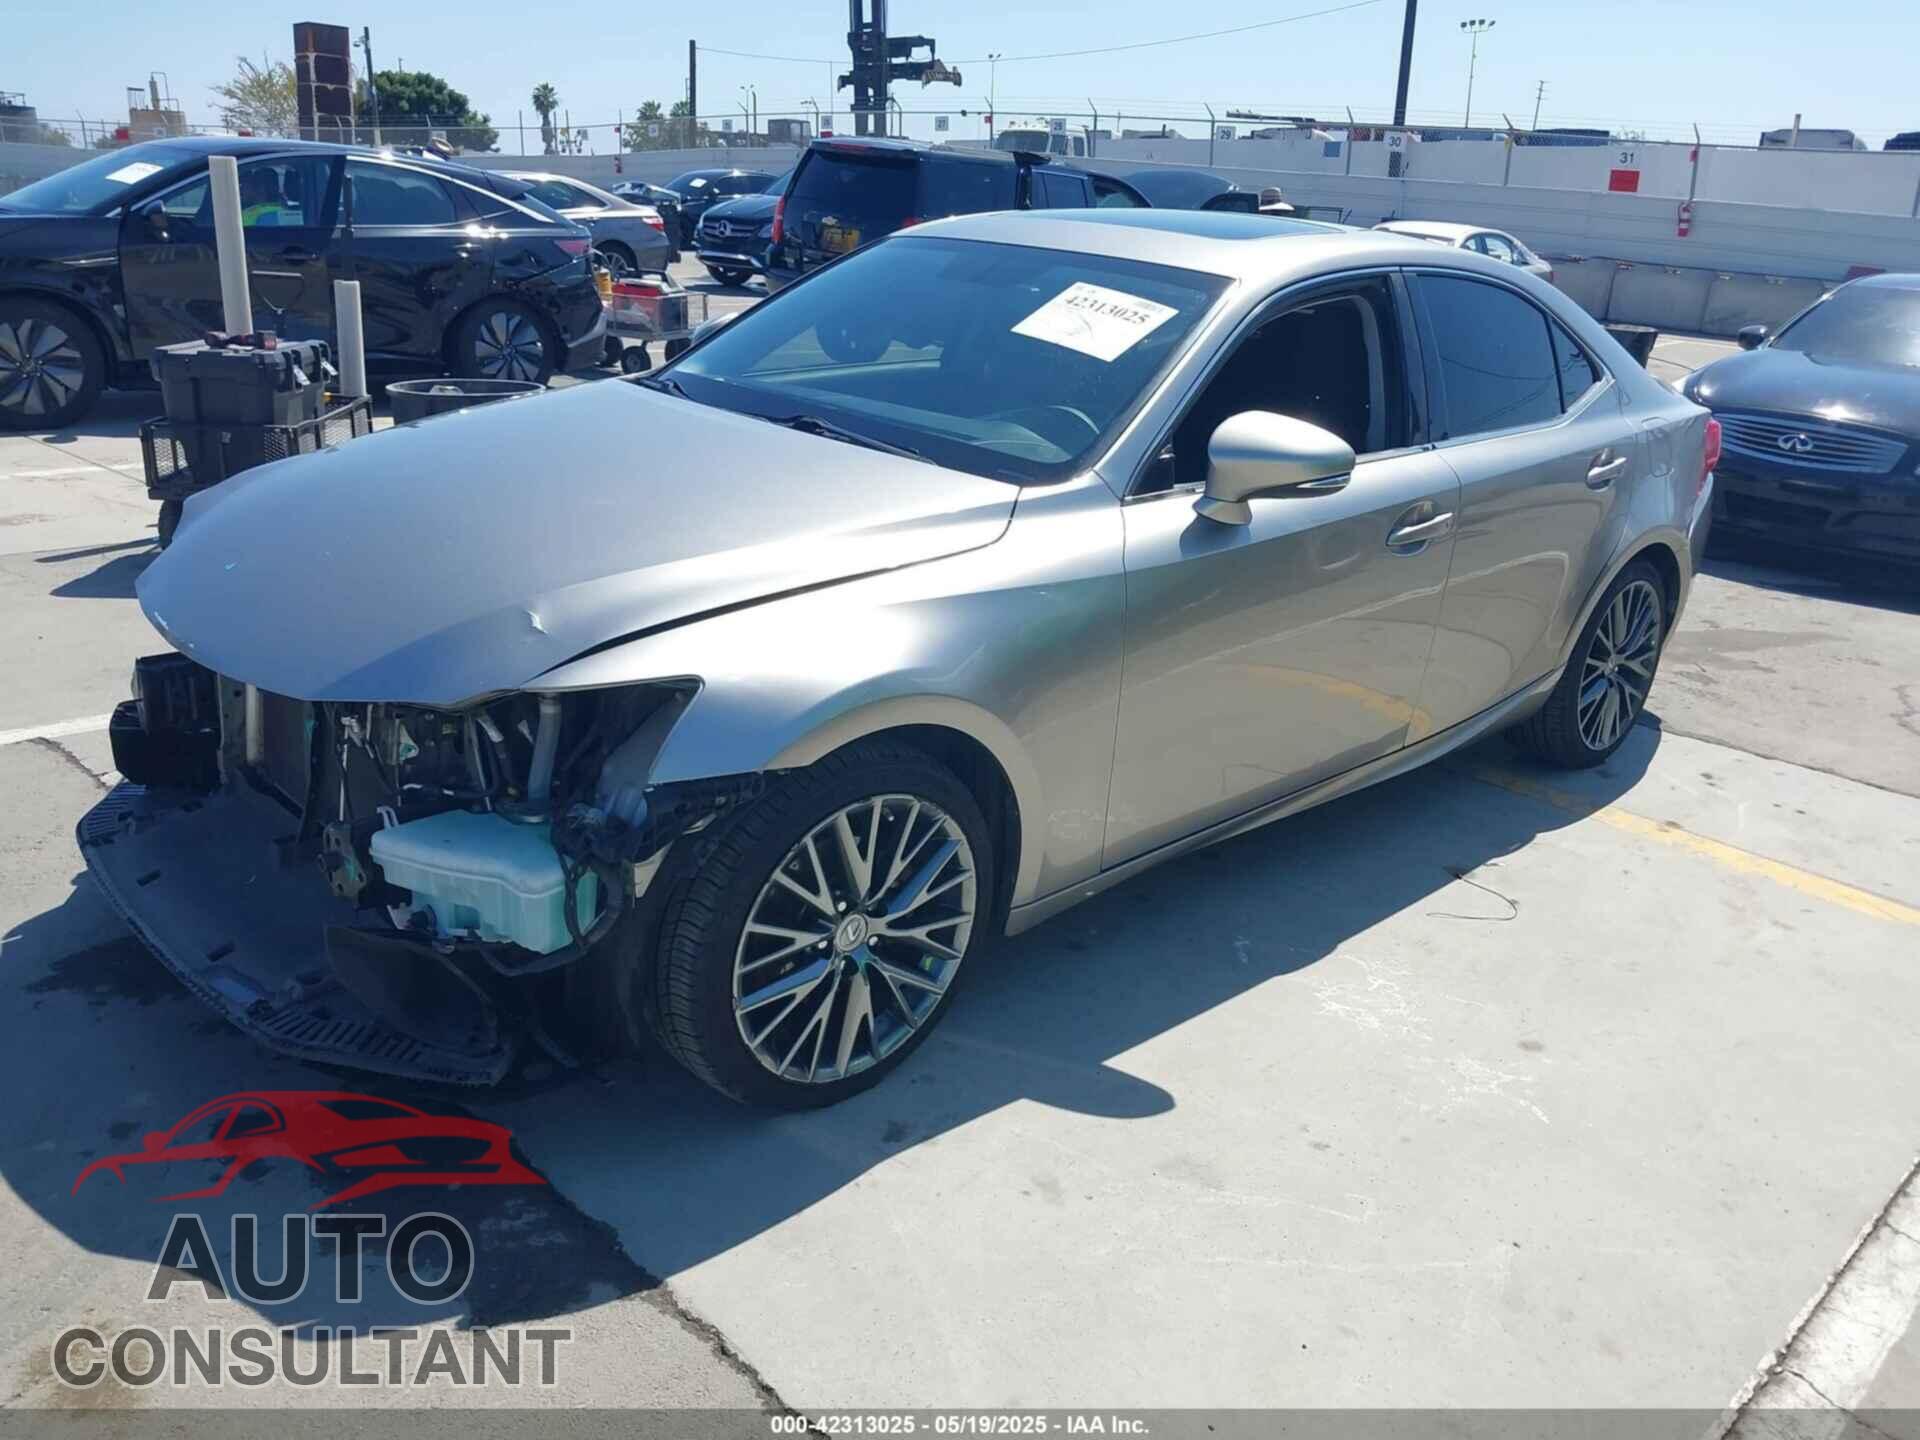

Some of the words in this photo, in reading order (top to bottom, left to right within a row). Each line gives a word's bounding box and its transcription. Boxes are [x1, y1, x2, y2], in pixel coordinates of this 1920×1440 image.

[1220, 128, 1232, 140] 29
[1389, 136, 1402, 147] 30
[1619, 152, 1635, 164] 31
[1065, 295, 1151, 325] 42313025
